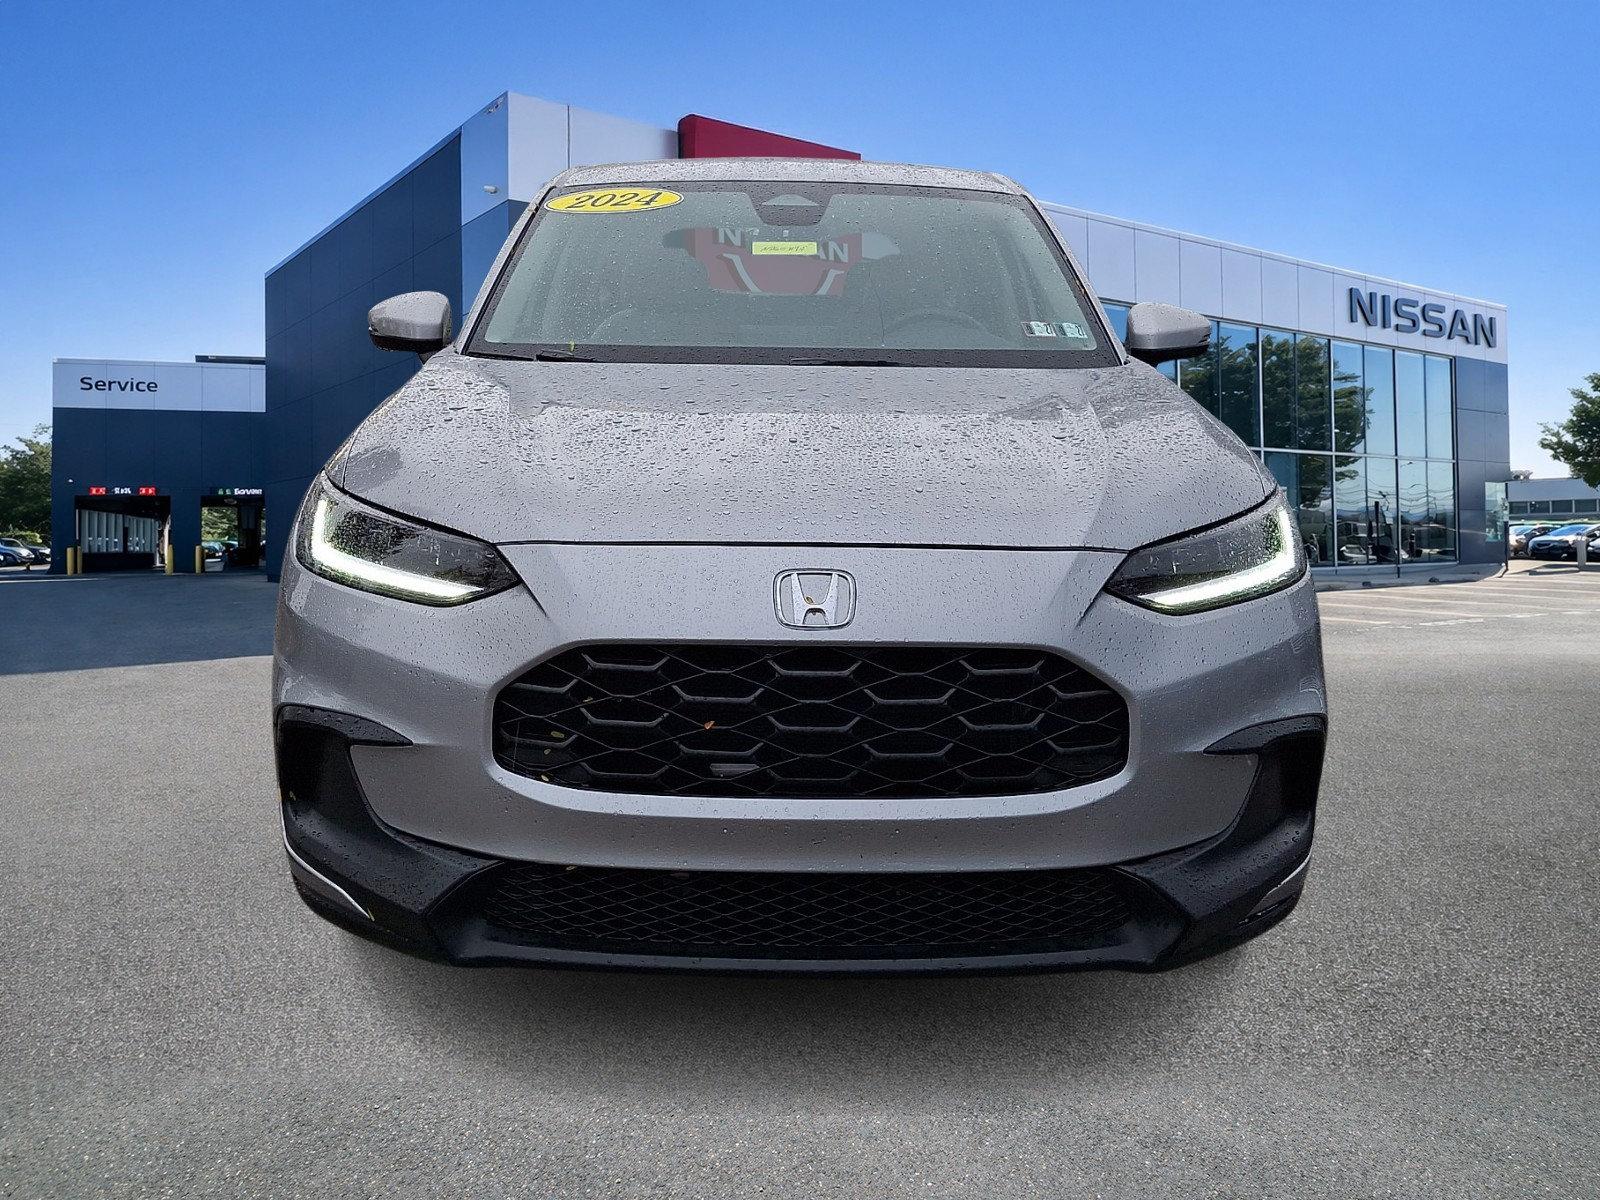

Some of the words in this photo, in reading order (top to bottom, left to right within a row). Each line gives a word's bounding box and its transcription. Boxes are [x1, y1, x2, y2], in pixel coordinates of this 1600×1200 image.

[565, 191, 663, 209] 2024
[1348, 287, 1497, 348] NISSAN
[79, 376, 159, 393] Service
